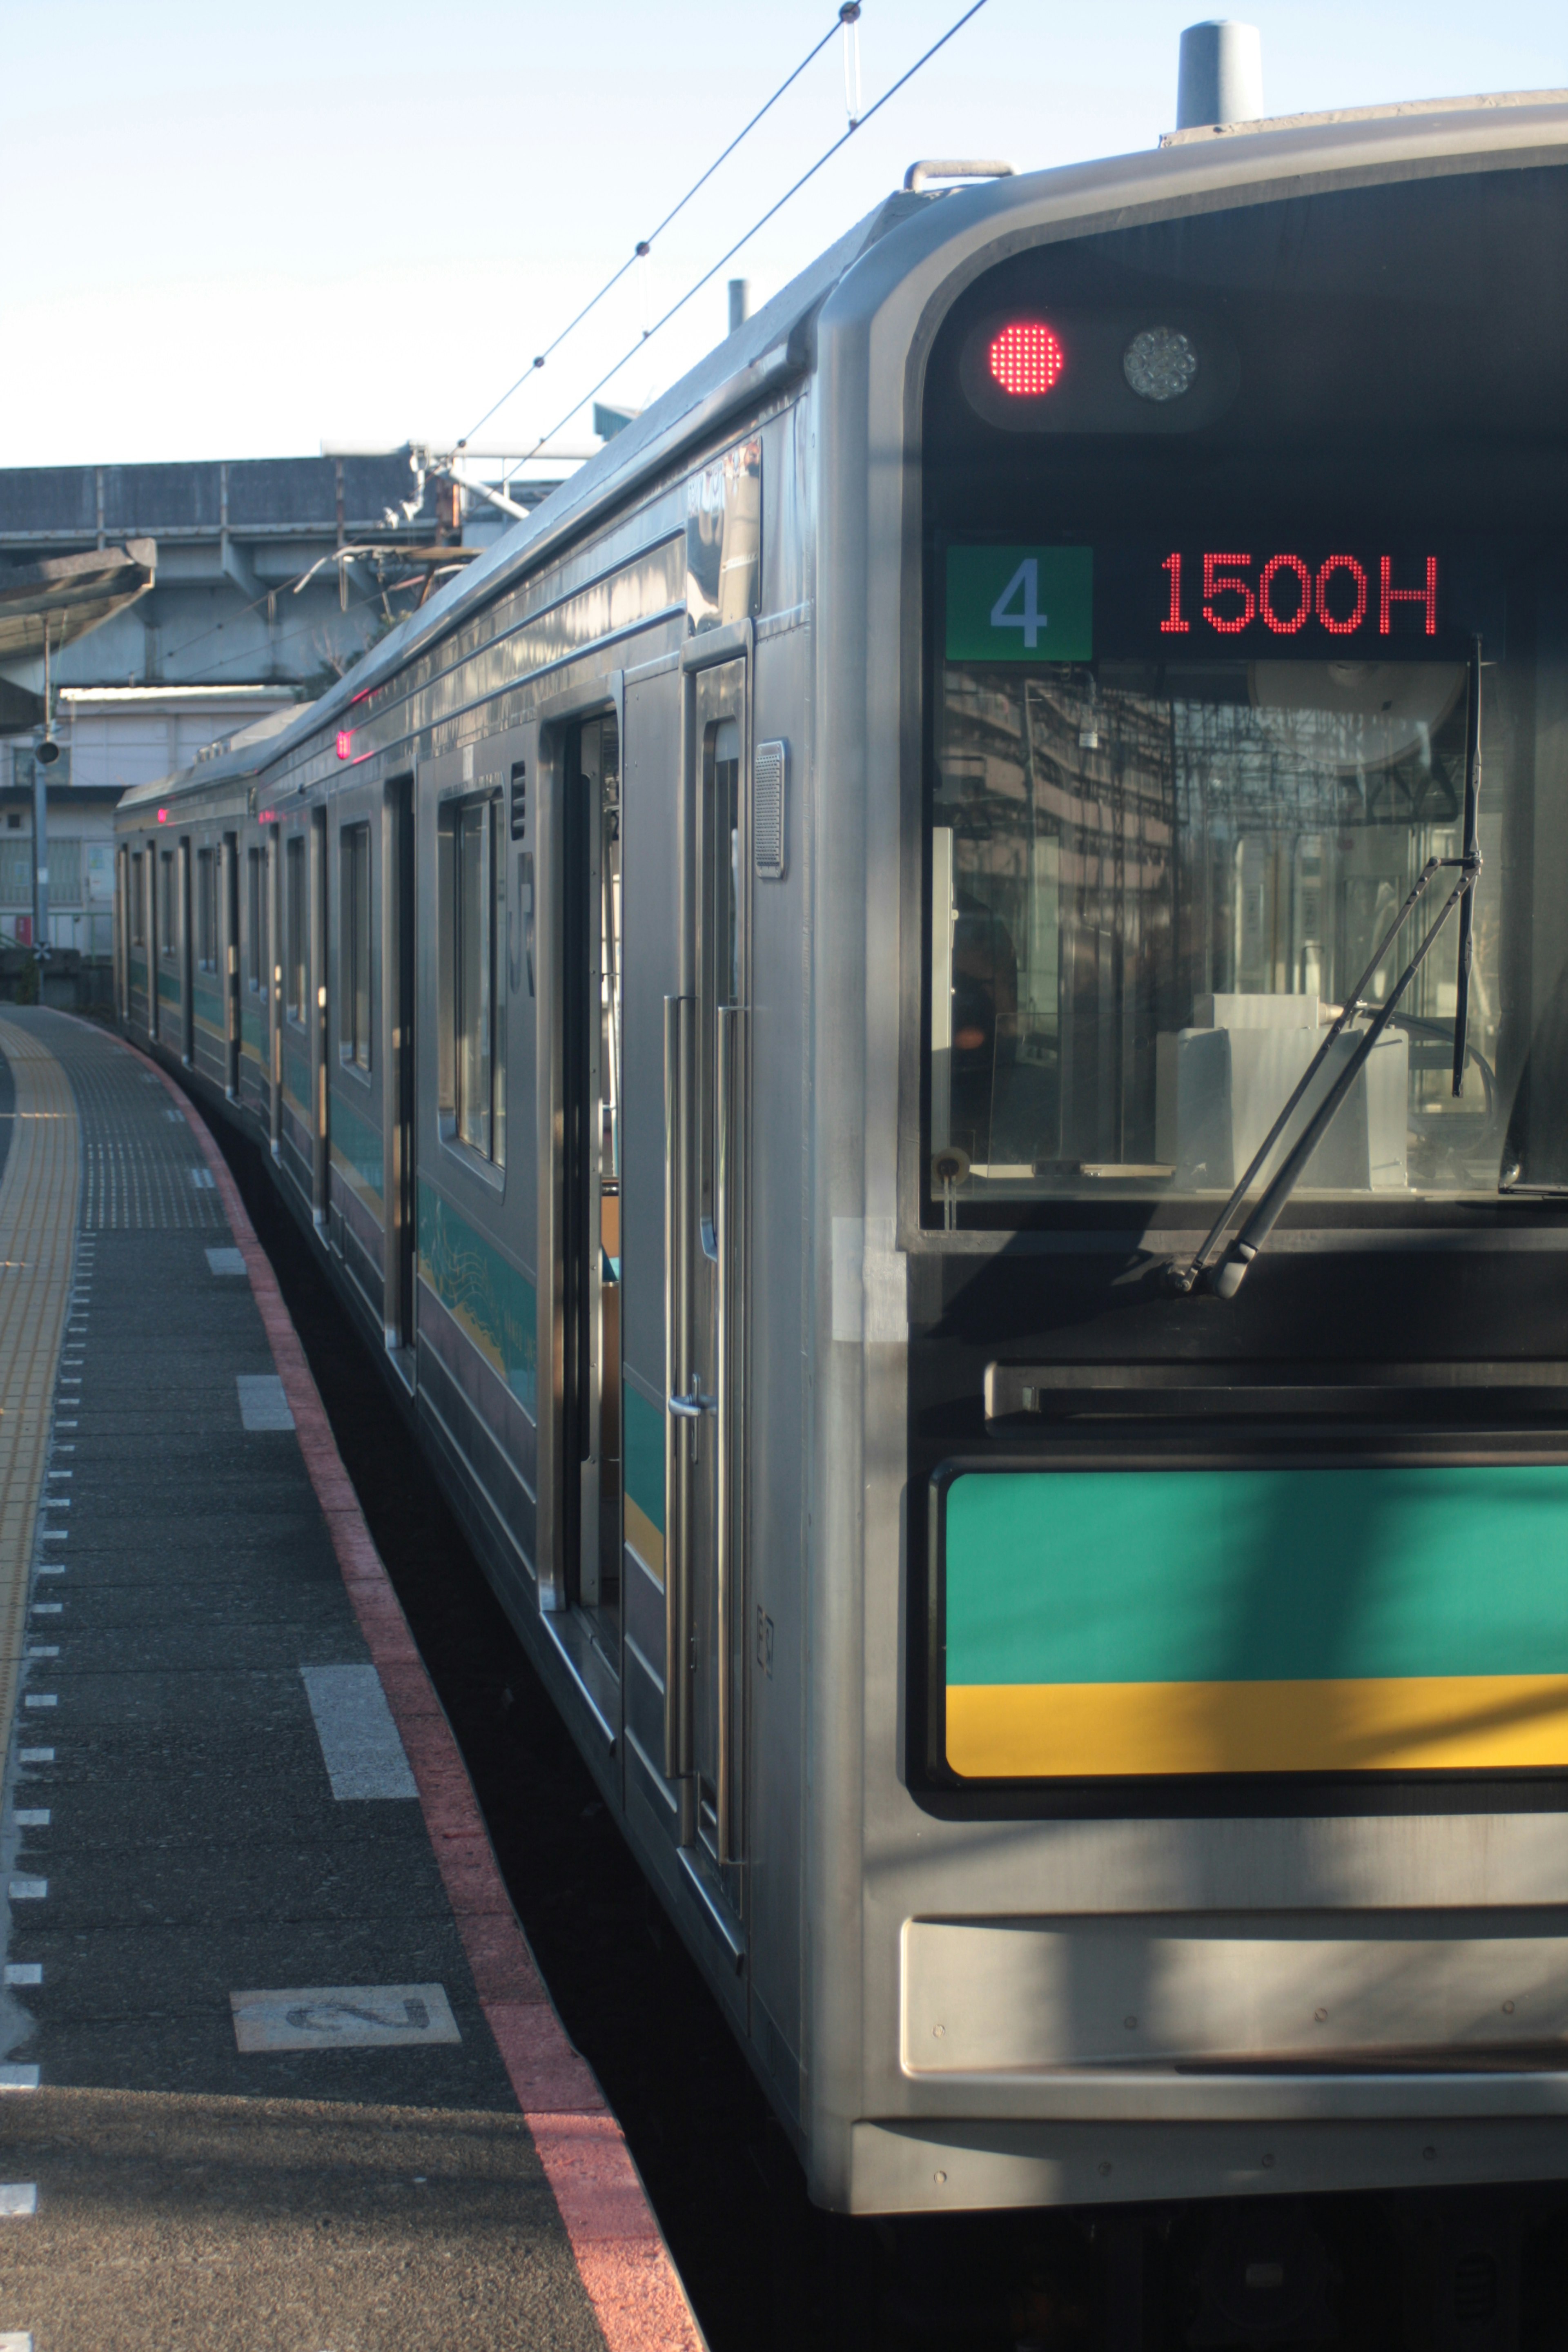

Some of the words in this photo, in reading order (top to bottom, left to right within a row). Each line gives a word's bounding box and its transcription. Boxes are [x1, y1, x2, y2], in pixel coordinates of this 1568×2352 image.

[991, 558, 1047, 648] 4
[1160, 553, 1437, 635] 1500H
[508, 851, 535, 998] JR
